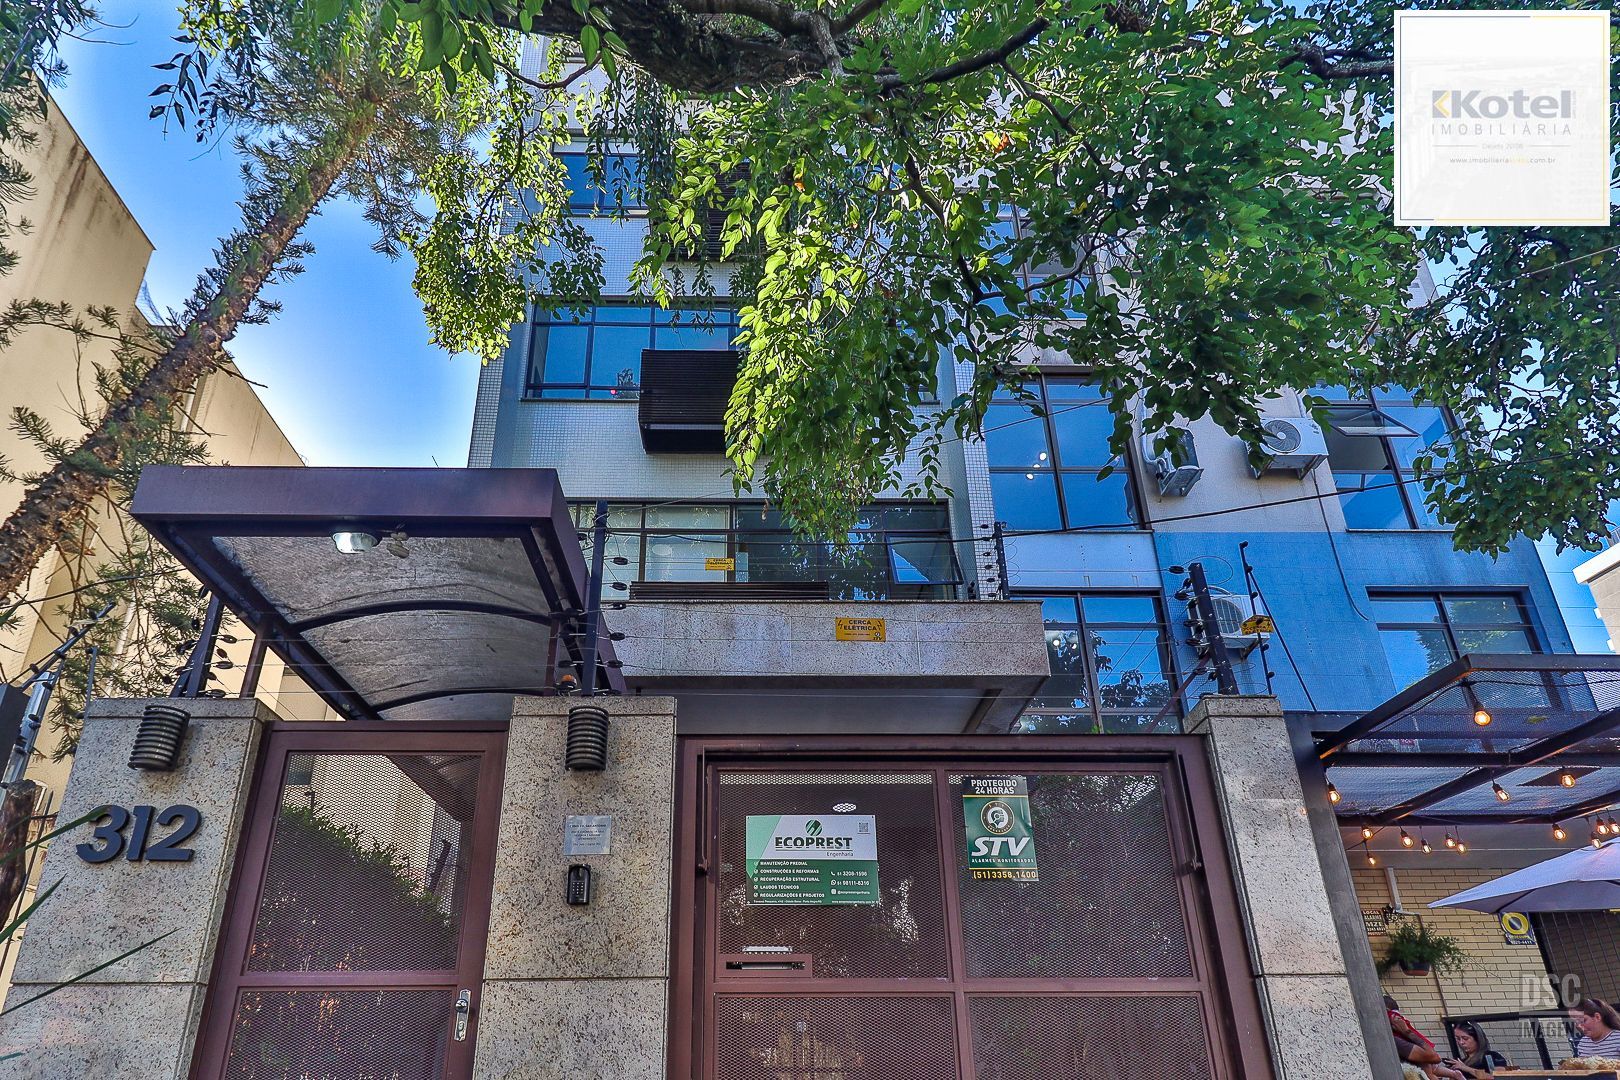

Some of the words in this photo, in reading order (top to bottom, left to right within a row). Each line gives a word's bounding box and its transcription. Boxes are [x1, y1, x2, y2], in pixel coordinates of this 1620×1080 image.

[970, 779, 1018, 787] PROTEGIDO
[974, 786, 985, 795] 24
[986, 786, 1015, 795] HORAS
[76, 804, 203, 864] 312
[774, 836, 853, 850] ECOPREST
[971, 836, 1031, 857] STV
[973, 870, 1036, 879] (51)3358.1400
